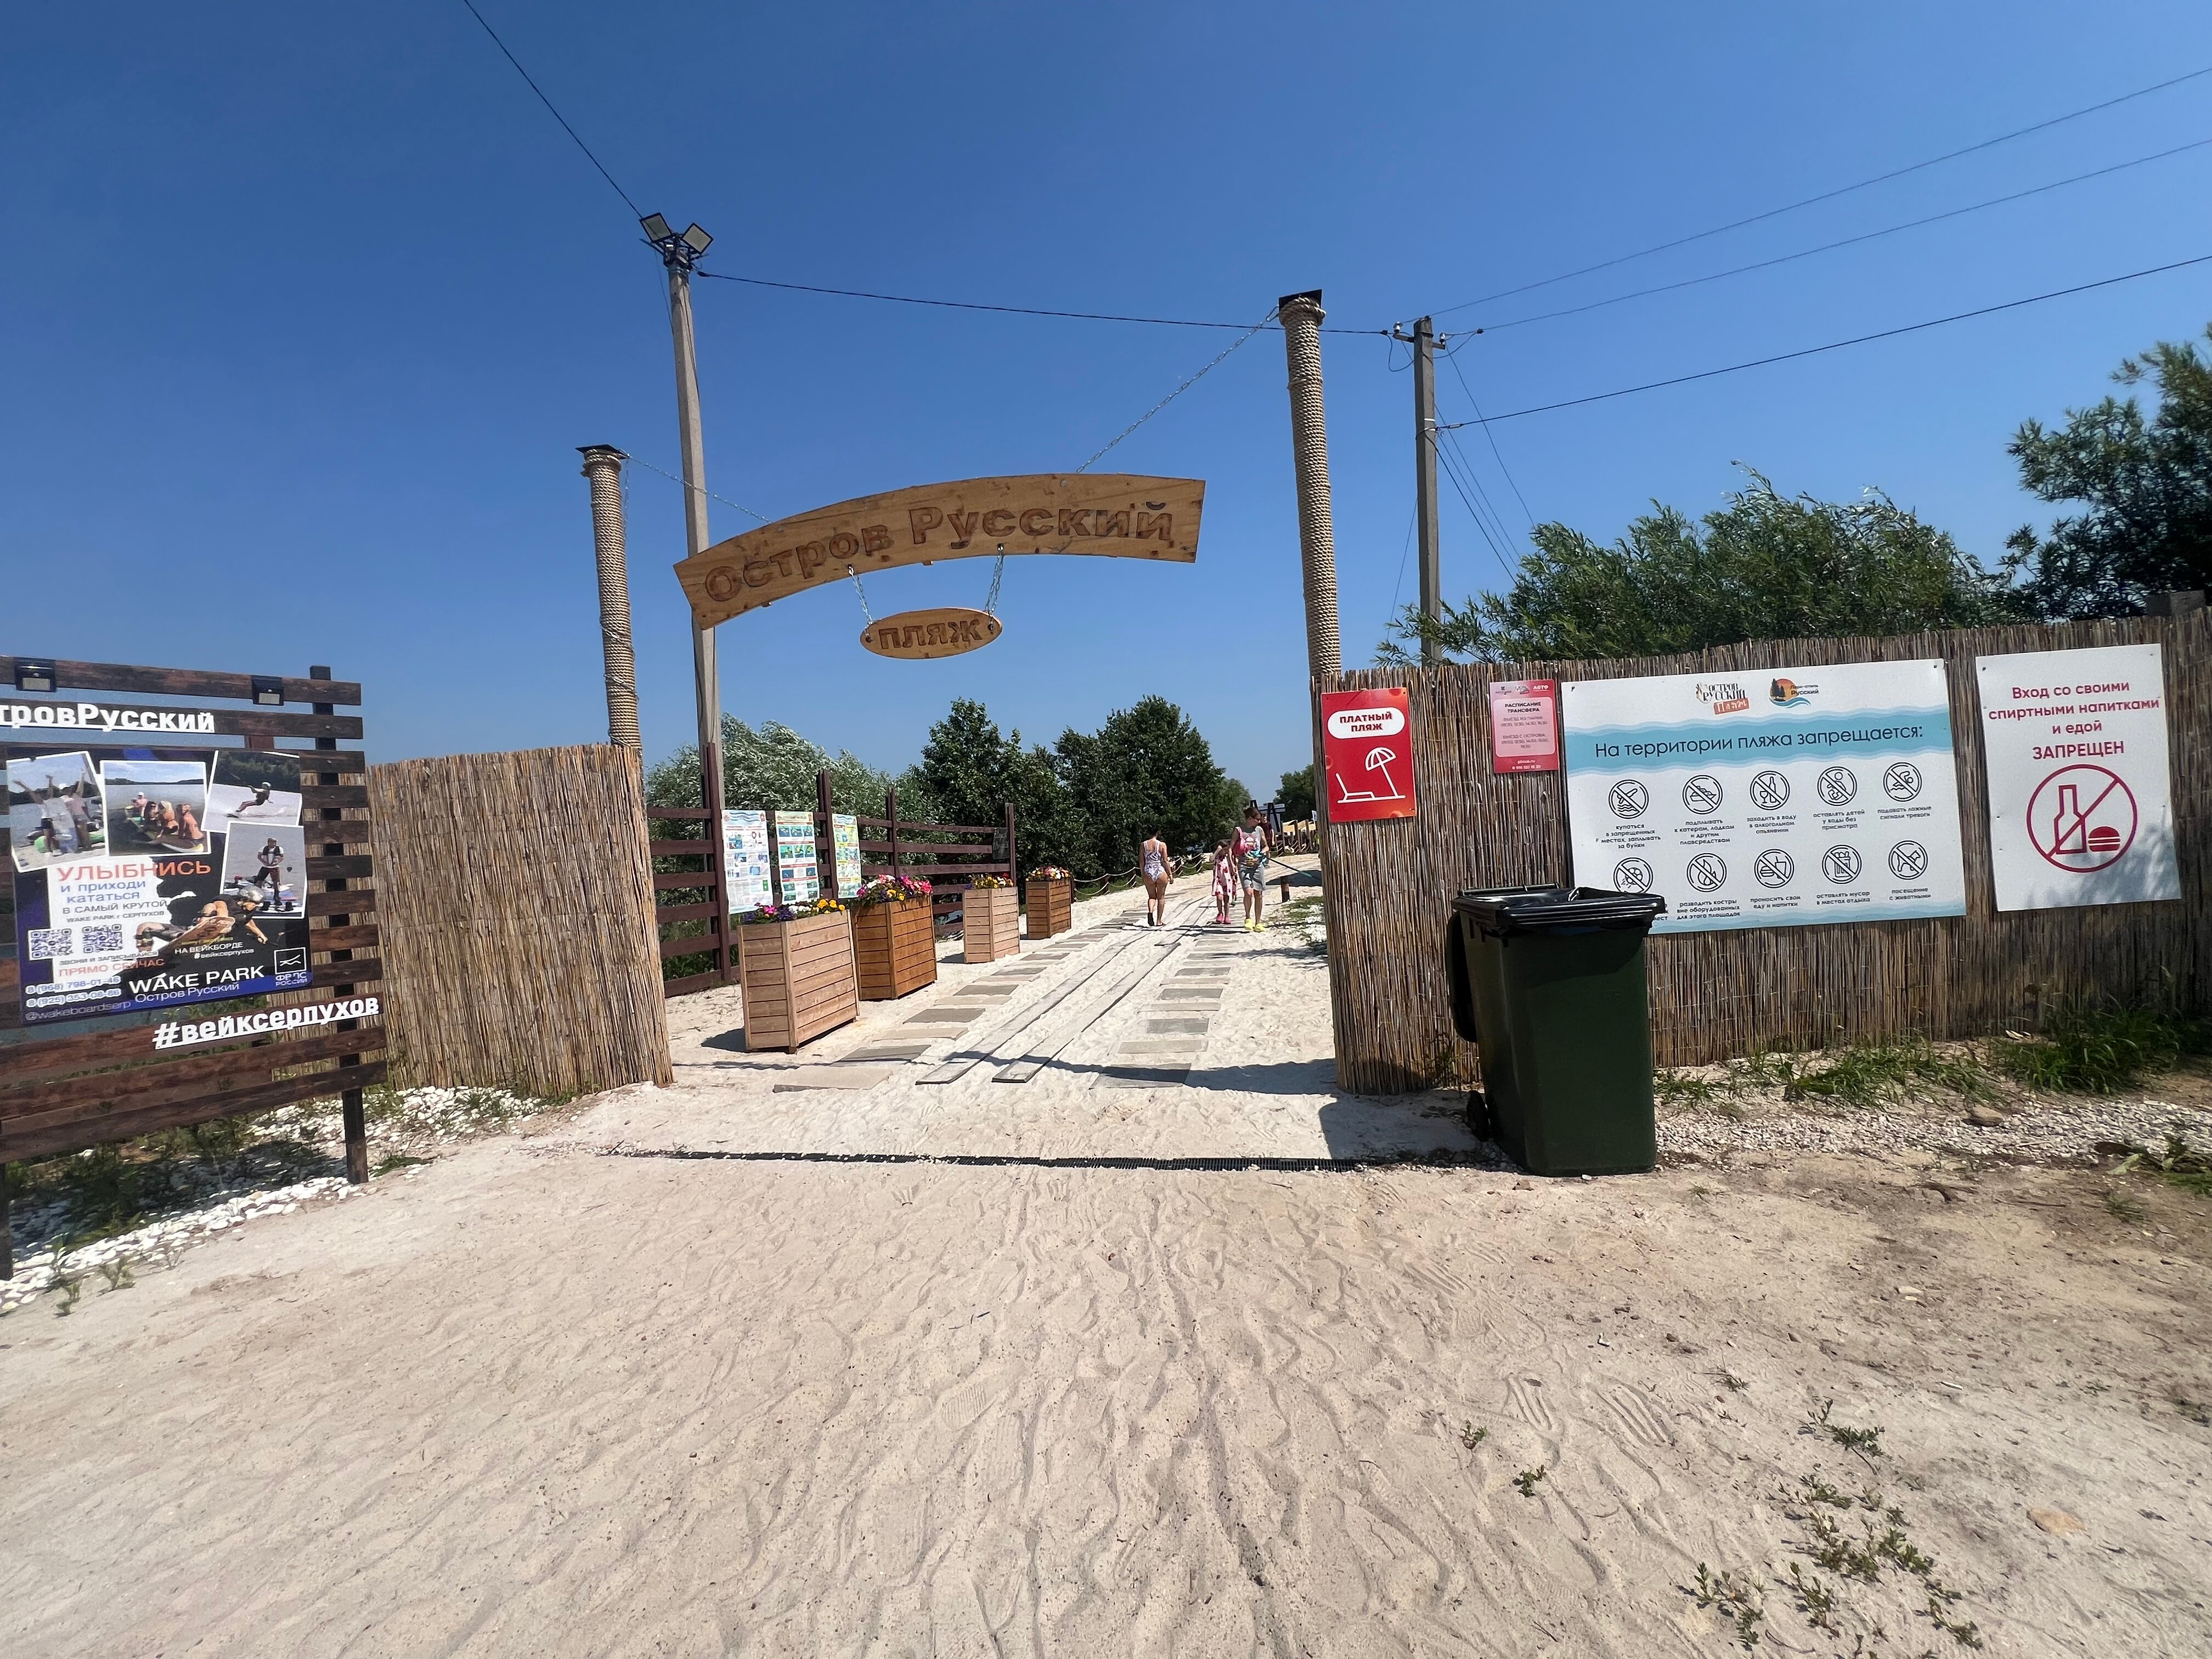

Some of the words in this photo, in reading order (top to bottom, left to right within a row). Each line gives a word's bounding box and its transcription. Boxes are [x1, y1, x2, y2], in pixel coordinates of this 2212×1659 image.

[705, 524, 894, 602] Остров
[909, 501, 1172, 549] Русский
[1708, 682, 1738, 691] ОСТРОВ
[2012, 687, 2050, 699] Вход
[2053, 687, 2071, 696] со
[2075, 682, 2130, 695] своими
[1988, 705, 2074, 720] спиртными
[2079, 699, 2160, 714] напитками
[1340, 711, 1392, 723] ПЛАТНЫЙ
[1351, 723, 1383, 732] ПЛЯЖ
[2052, 725, 2061, 735] и
[2066, 720, 2102, 735] едой
[1595, 743, 1620, 758] На
[1624, 737, 1733, 755] территории
[1738, 734, 1792, 749] пляжа
[1797, 725, 1923, 746] запрещается:
[2032, 741, 2124, 760] ЗАПРЕЩЕН
[57, 860, 211, 882] УЛЫБНИСЬ
[60, 884, 70, 893] и
[78, 881, 146, 892] приходи
[67, 891, 140, 904] кататься
[74, 904, 119, 913] САМЫЙ
[123, 899, 168, 910] КРУТОЙ
[123, 910, 165, 918] СЕРПУХОВ
[189, 941, 244, 953] ВЕЙКБОРДЕ
[194, 948, 255, 960] #вейксерпухов
[98, 951, 157, 962] ЗАПИСЫВАЙСЯ
[58, 964, 109, 977] ПРЯМО
[128, 972, 200, 994] WAKE
[206, 965, 264, 985] PARK
[275, 978, 307, 986] РОССИИ
[134, 989, 185, 1003] Остров
[188, 982, 239, 997] Русский
[25, 1001, 131, 1020] @wakeboardserp
[153, 997, 379, 1049] #вейксерпухов
